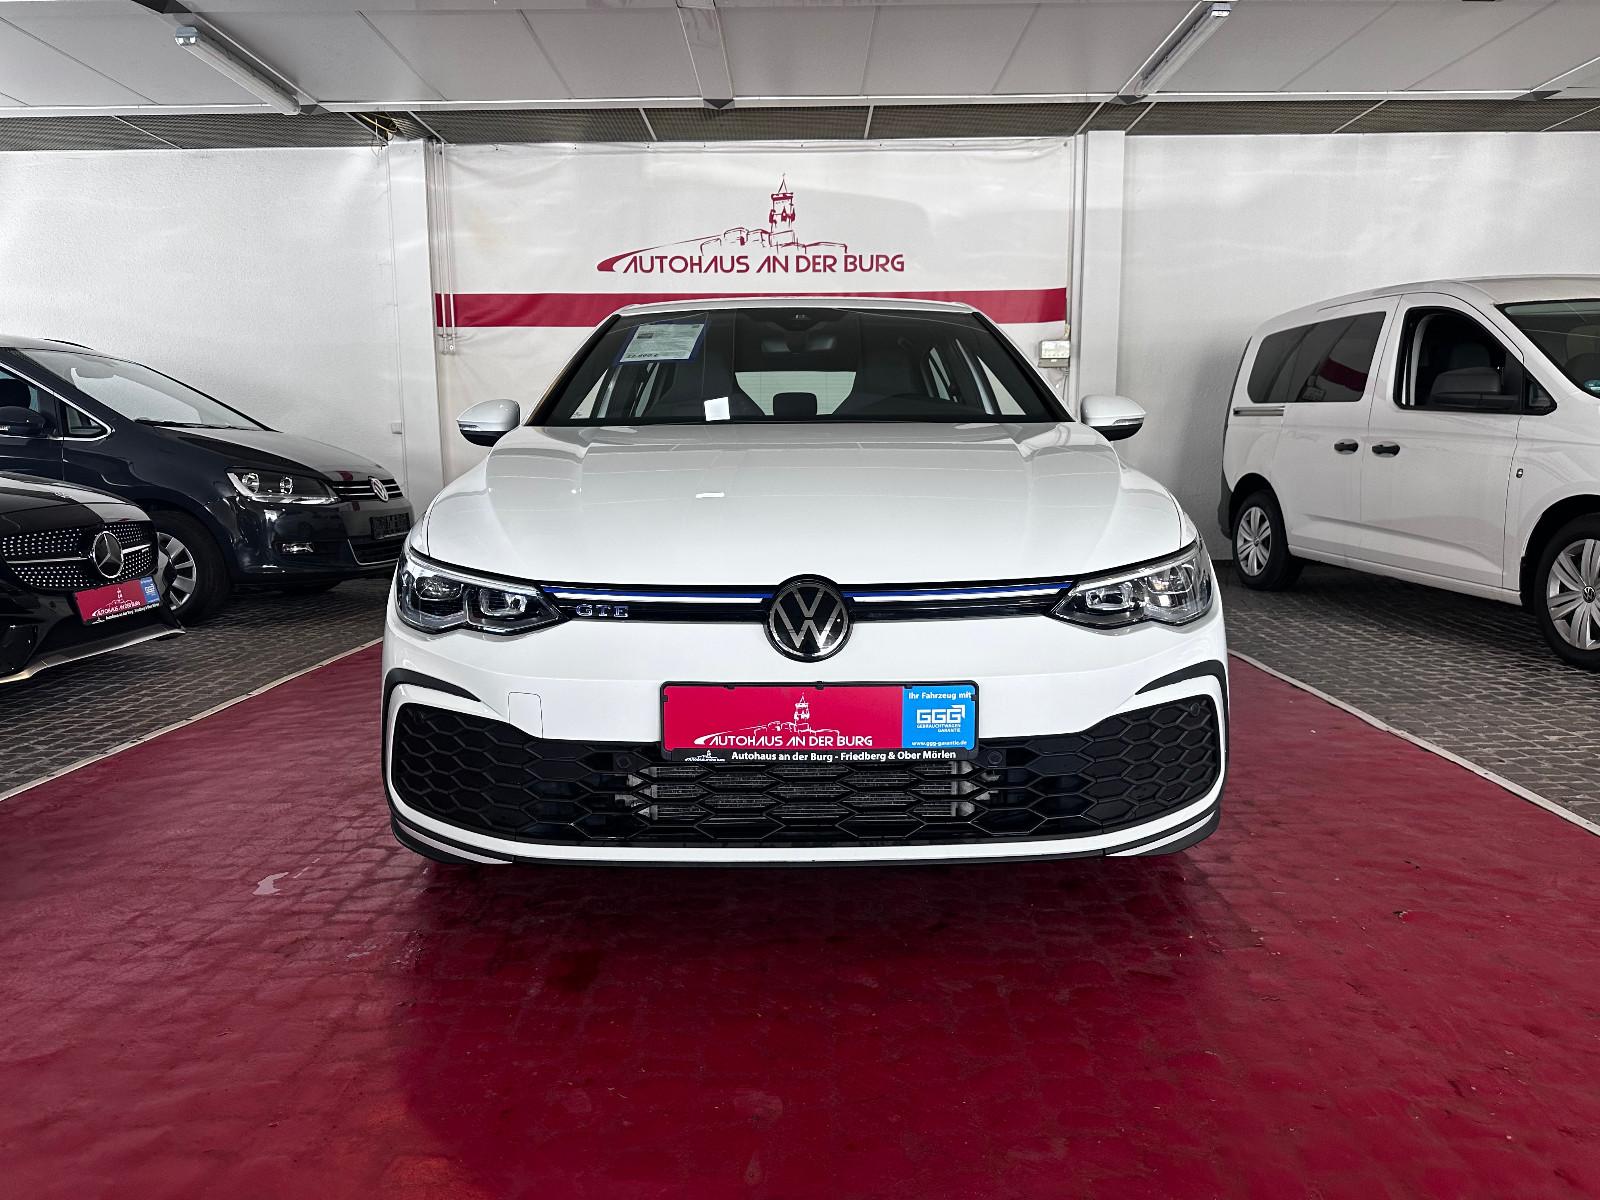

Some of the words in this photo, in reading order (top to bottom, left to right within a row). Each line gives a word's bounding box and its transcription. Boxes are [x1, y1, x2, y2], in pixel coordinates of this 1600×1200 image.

[623, 255, 750, 273] AUTOHAUS
[756, 255, 788, 273] AN
[795, 254, 837, 273] DER
[844, 254, 904, 272] BURG
[576, 604, 628, 617] GTE
[908, 691, 919, 700] Ihr
[922, 691, 956, 700] Fahrzeug
[959, 691, 972, 699] mit
[917, 707, 963, 724] GGG
[709, 736, 783, 746] AUTOHAUS
[786, 736, 806, 746] AN
[809, 736, 833, 746] DER
[837, 736, 873, 746] BURG
[731, 751, 776, 760] Autohaus
[792, 752, 808, 760] der
[811, 752, 833, 763] Burg
[840, 751, 886, 762] Friedberg
[888, 751, 895, 760] &
[897, 750, 921, 759] Ober
[923, 750, 956, 759] Mörlen
